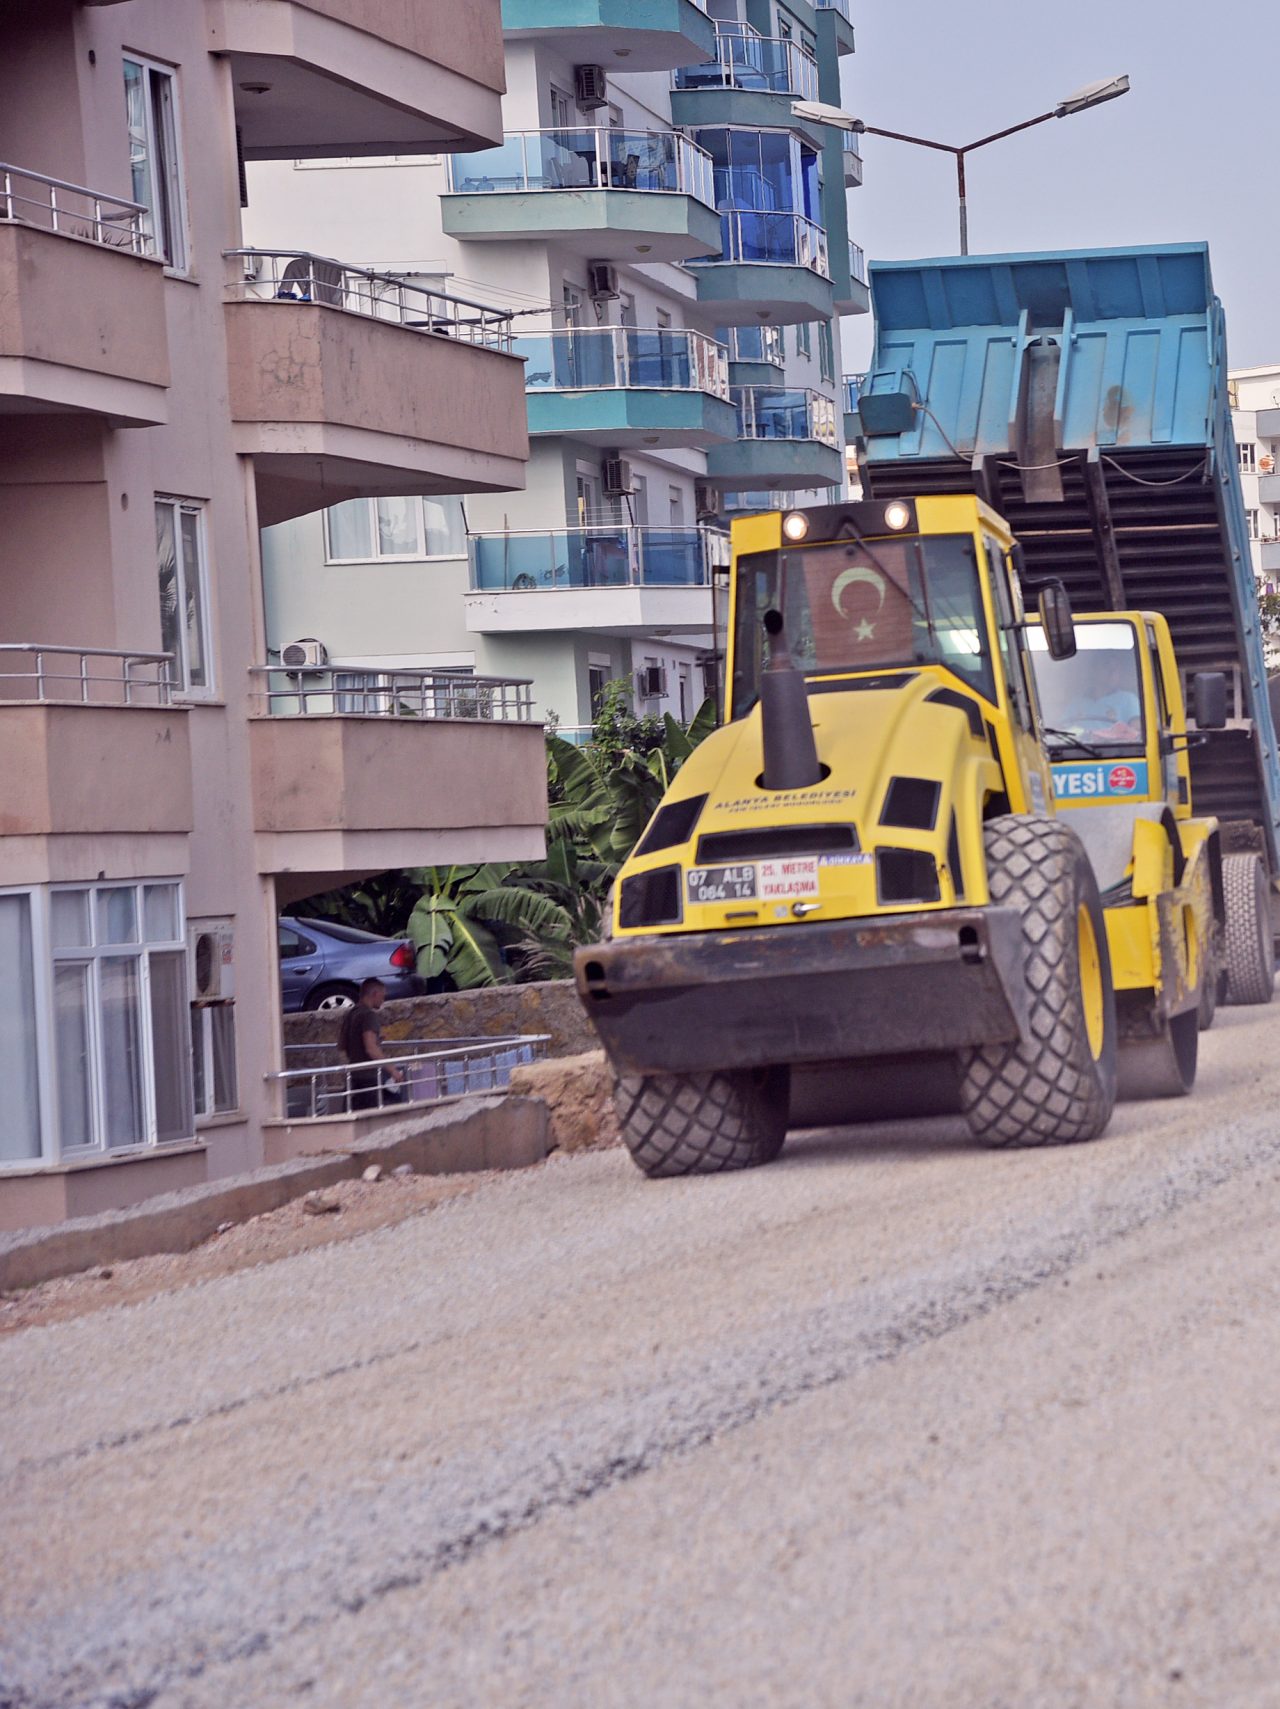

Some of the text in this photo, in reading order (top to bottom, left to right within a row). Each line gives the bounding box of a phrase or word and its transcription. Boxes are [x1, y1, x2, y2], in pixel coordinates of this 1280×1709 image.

[1052, 767, 1105, 795] YESİ
[715, 796, 768, 809] ALANYA
[782, 861, 816, 875] METRE
[688, 866, 754, 887] 07 ALB
[735, 882, 752, 898] 14
